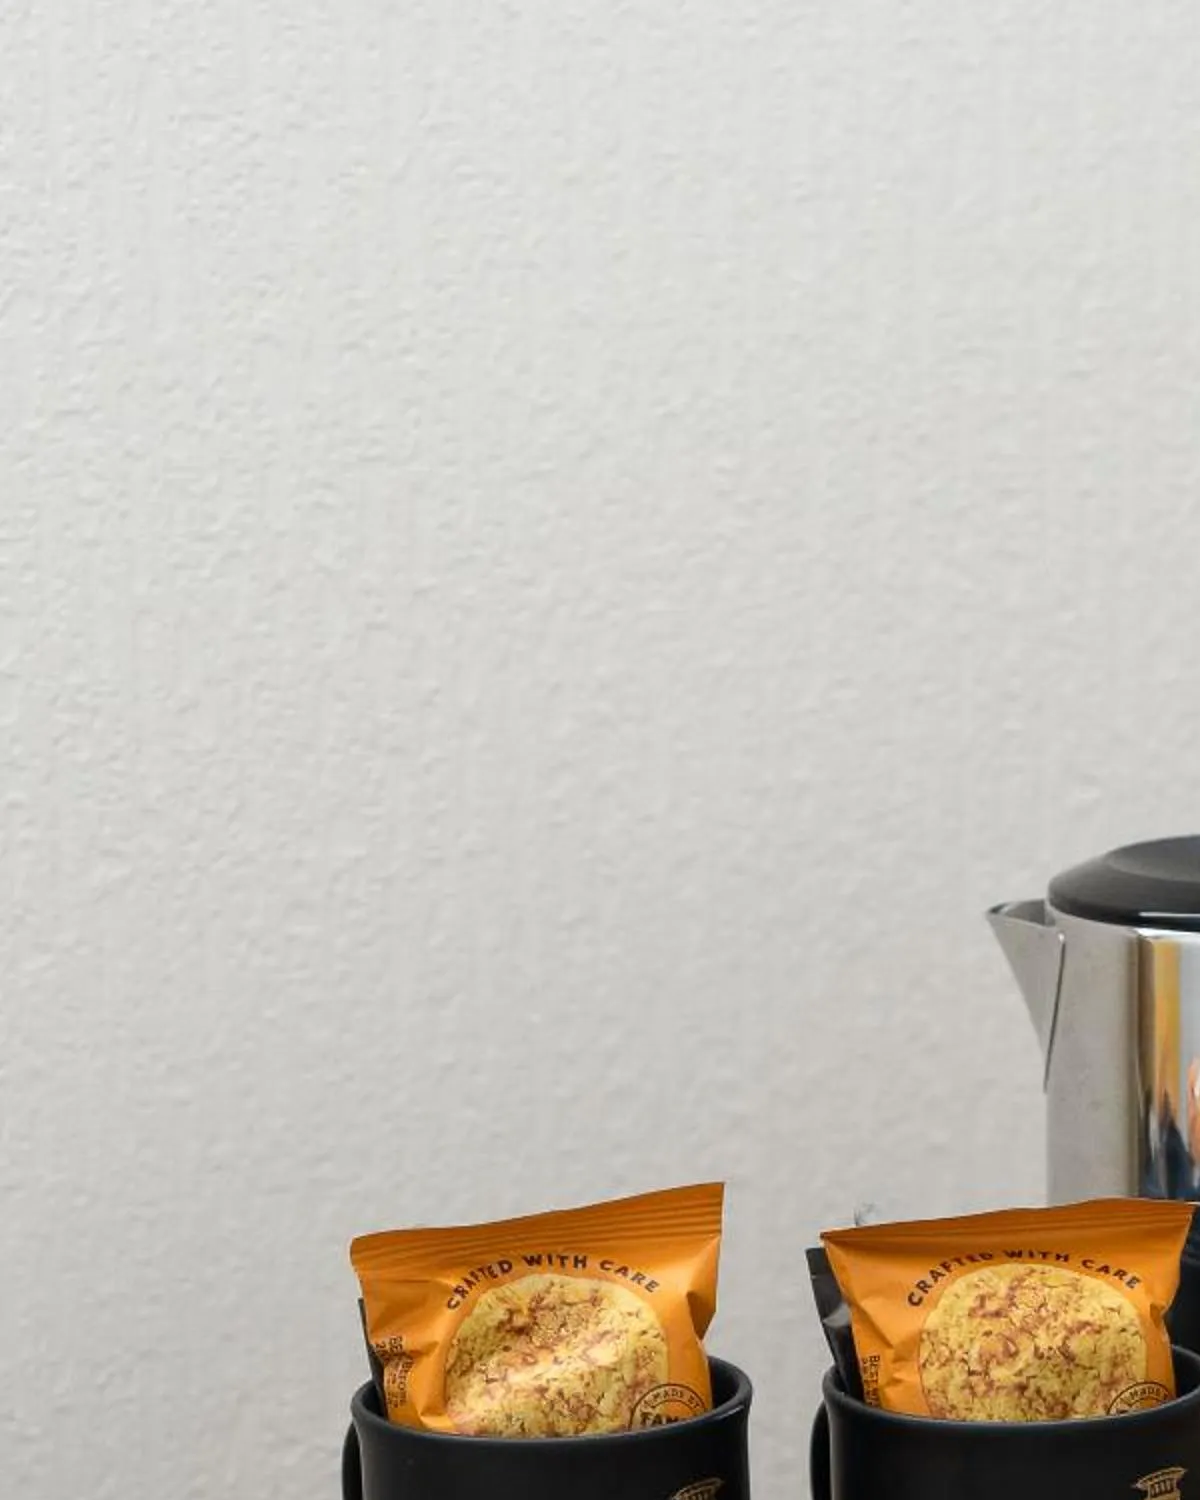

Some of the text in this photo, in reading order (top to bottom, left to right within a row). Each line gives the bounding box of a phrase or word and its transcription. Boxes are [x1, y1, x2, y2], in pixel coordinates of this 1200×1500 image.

[447, 1253, 660, 1310] CRAFTED WITH CARE
[907, 1250, 1142, 1307] CRAFTED WITH CARE
